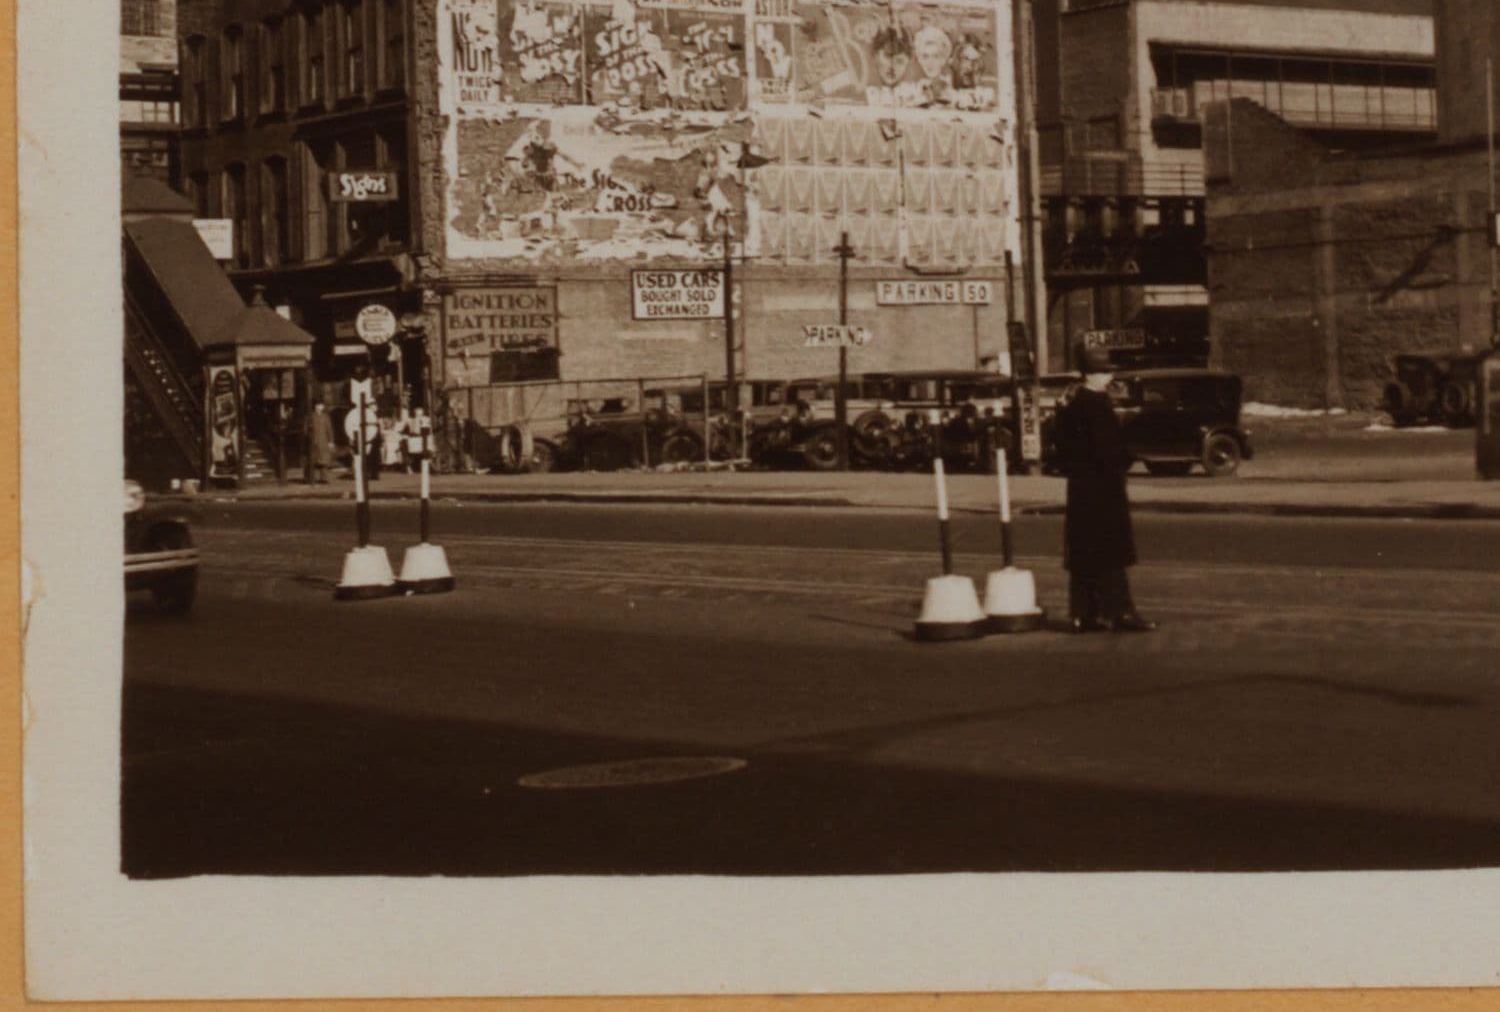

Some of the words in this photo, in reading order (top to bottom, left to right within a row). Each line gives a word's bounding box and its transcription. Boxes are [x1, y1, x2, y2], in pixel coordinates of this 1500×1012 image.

[340, 172, 387, 201] Signs
[636, 272, 676, 289] USED
[680, 271, 721, 287] CARS
[641, 289, 682, 304] BOUGHT
[686, 289, 717, 303] SOLD
[881, 283, 956, 301] PARKING
[452, 292, 548, 311] IGNITION
[646, 302, 711, 317] EXCHANGED
[449, 314, 553, 330] BATTERIES
